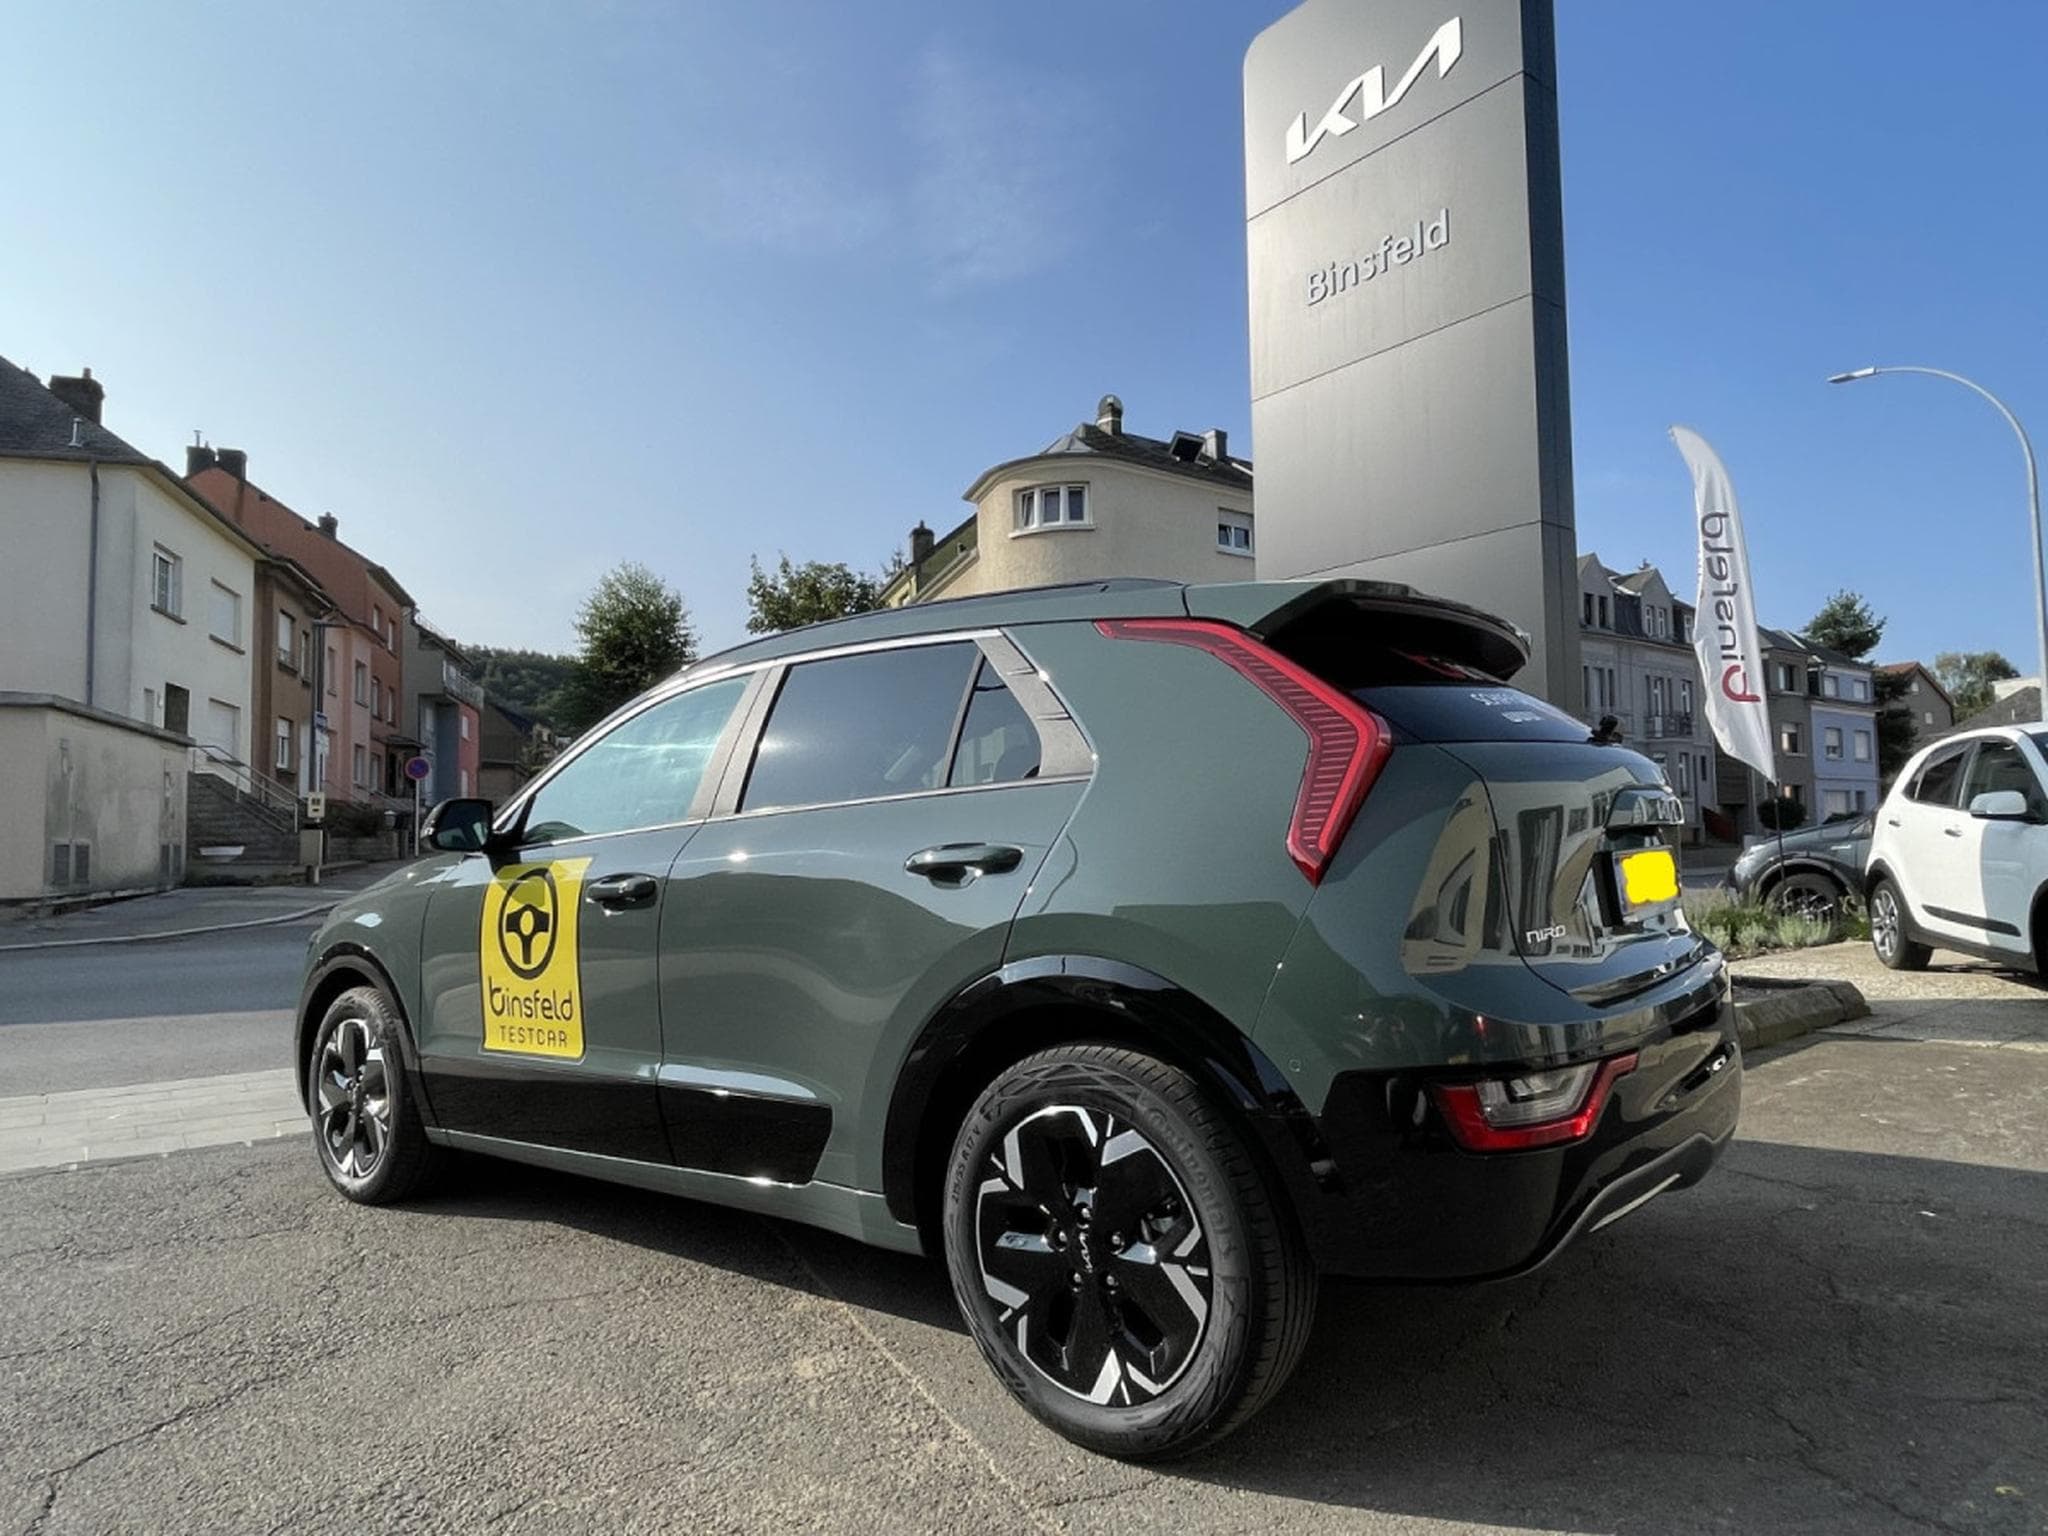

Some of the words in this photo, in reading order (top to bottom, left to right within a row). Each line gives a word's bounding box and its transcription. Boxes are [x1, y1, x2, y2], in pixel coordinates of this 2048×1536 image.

[1307, 207, 1450, 306] Binsfeld
[488, 976, 573, 1022] binsfeld
[500, 1024, 568, 1048] TESTCAR
